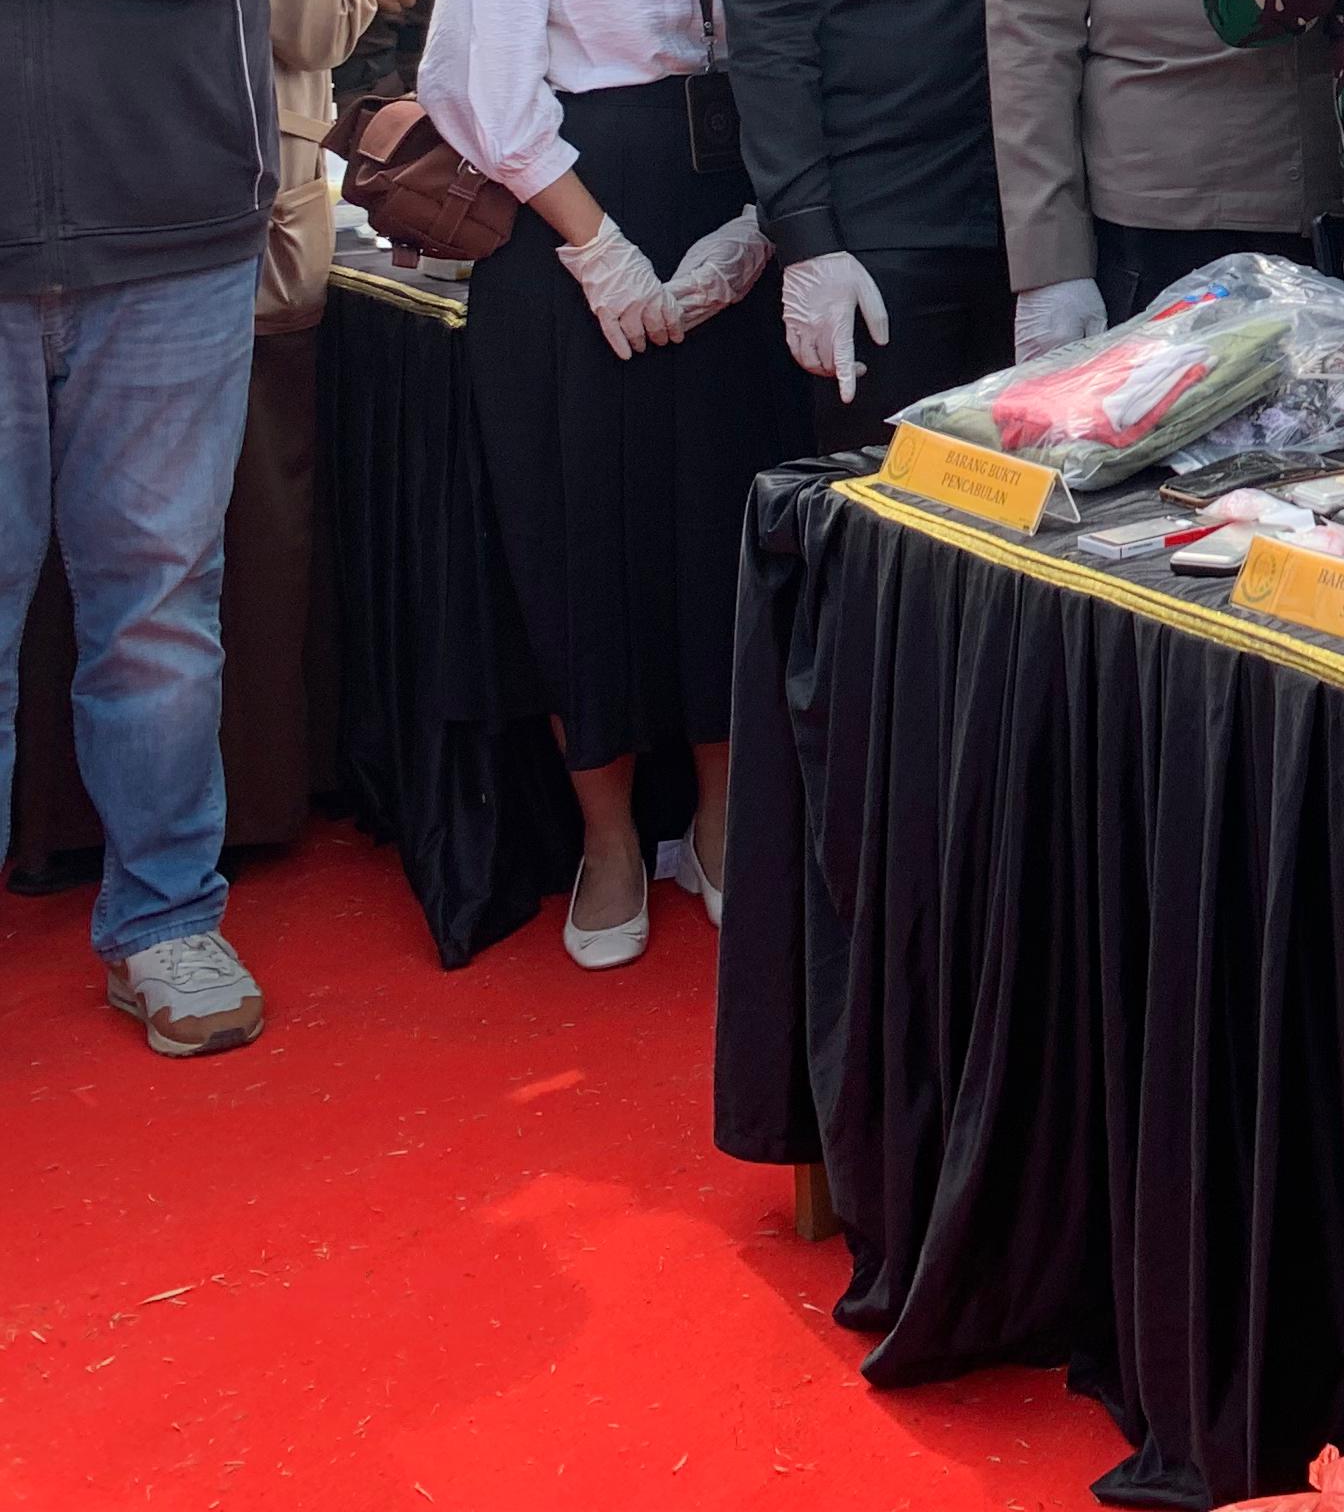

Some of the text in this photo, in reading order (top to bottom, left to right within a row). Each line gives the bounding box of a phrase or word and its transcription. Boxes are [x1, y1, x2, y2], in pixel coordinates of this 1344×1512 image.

[945, 449, 1022, 486] BARANG BUKTI
[941, 473, 1009, 506] PENCABULAN
